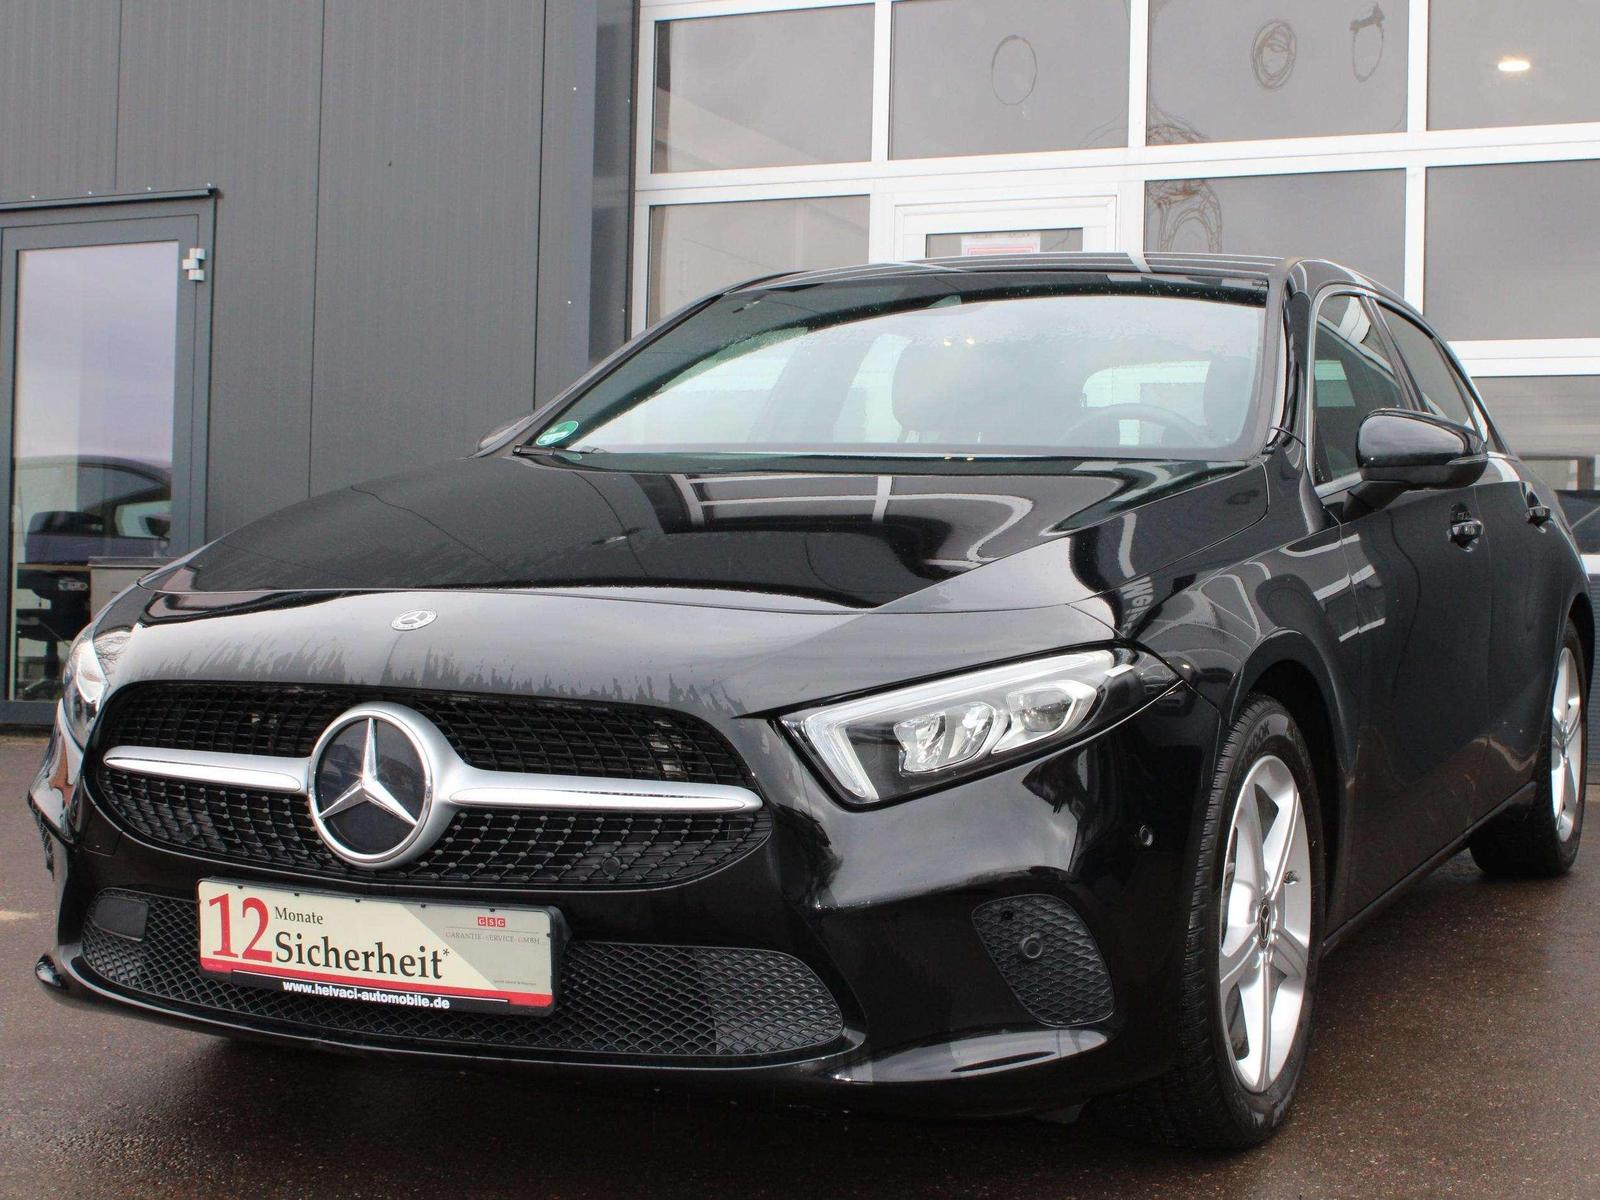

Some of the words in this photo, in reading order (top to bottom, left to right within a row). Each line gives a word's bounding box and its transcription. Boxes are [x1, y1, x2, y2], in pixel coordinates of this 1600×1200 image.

[208, 892, 273, 964] 12
[274, 906, 324, 926] Monate
[282, 979, 450, 1010] www.helvaci-automobile.de
